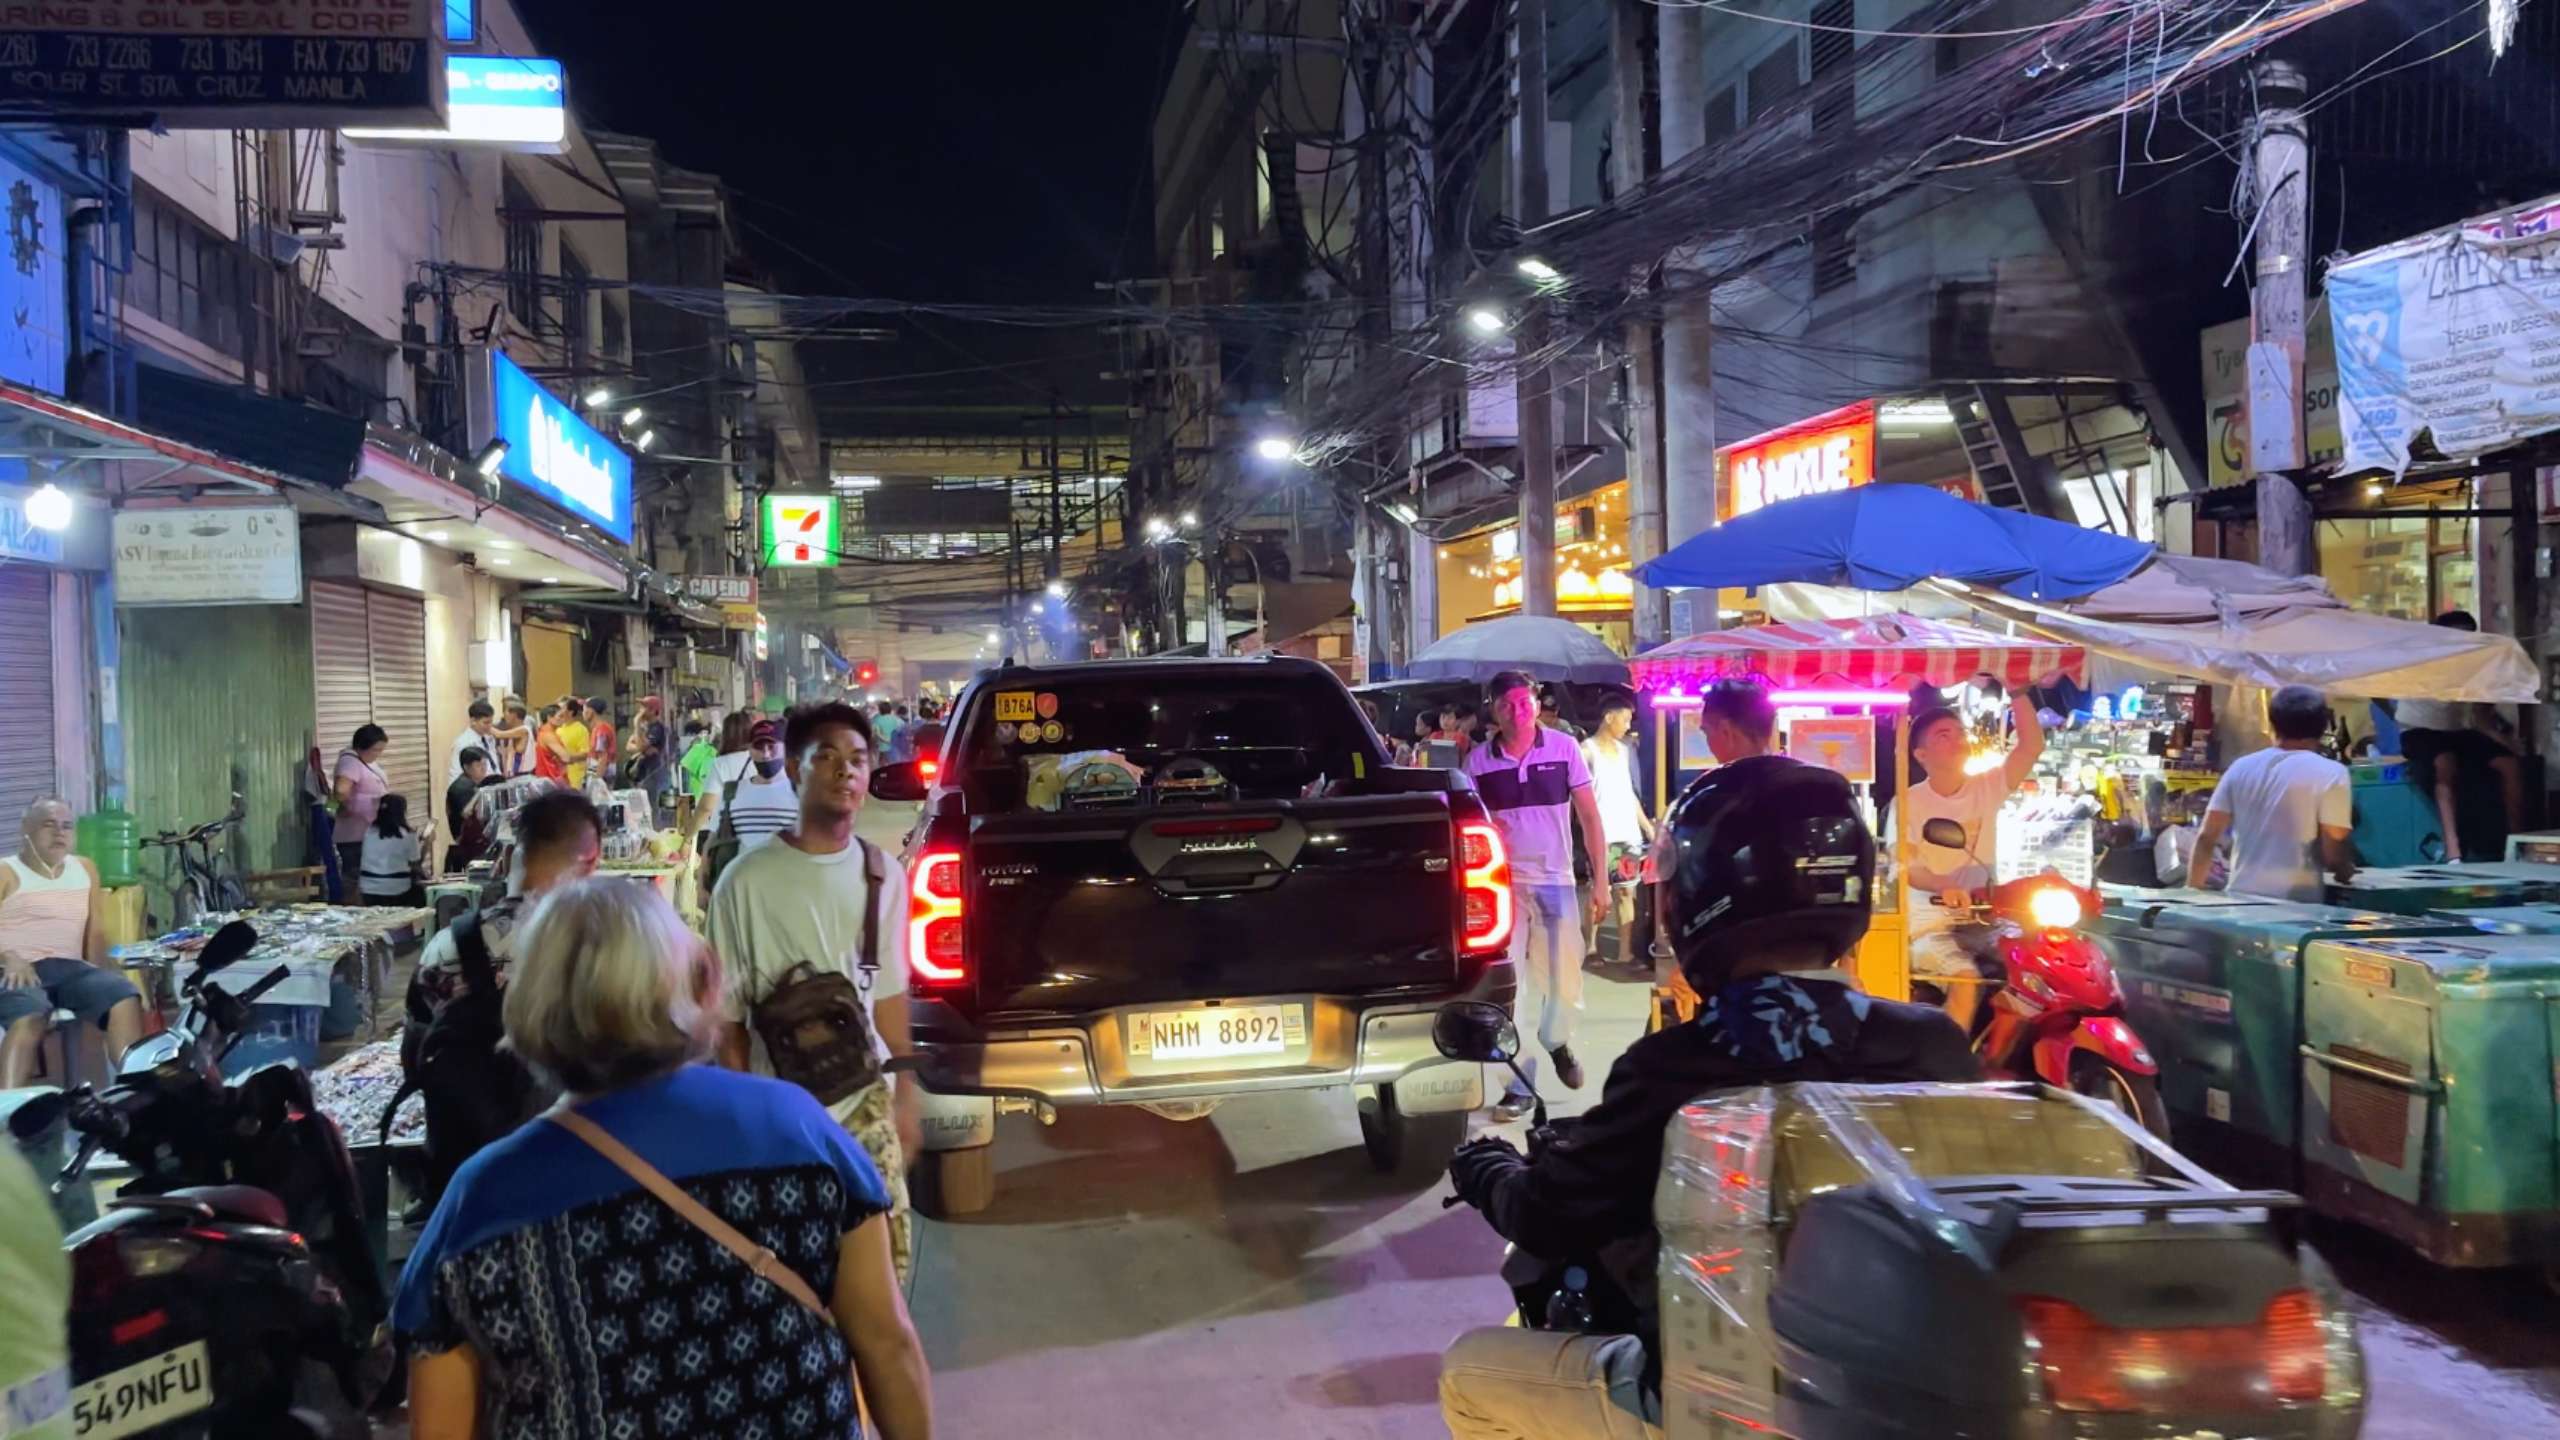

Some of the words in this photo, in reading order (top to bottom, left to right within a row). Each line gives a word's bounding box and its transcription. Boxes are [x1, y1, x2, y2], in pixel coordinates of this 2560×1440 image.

[0, 6, 94, 27] RING
[136, 11, 188, 28] OIL
[204, 11, 297, 30] SEAL
[311, 12, 410, 32] CORP
[65, 34, 100, 68] 733
[106, 37, 151, 70] 2266
[178, 37, 215, 71] 733
[223, 39, 264, 72] 1641
[293, 39, 329, 72] FAX
[336, 40, 370, 73] 733
[283, 76, 367, 99] MANILA
[1765, 436, 1852, 505] MIXUE
[688, 578, 750, 598] CALERO
[1002, 698, 1034, 714] 876A
[1682, 894, 1733, 937] LS2
[1154, 1020, 1201, 1049] NHM
[1219, 1016, 1280, 1045] 8892
[72, 1357, 201, 1436] 549NFU
